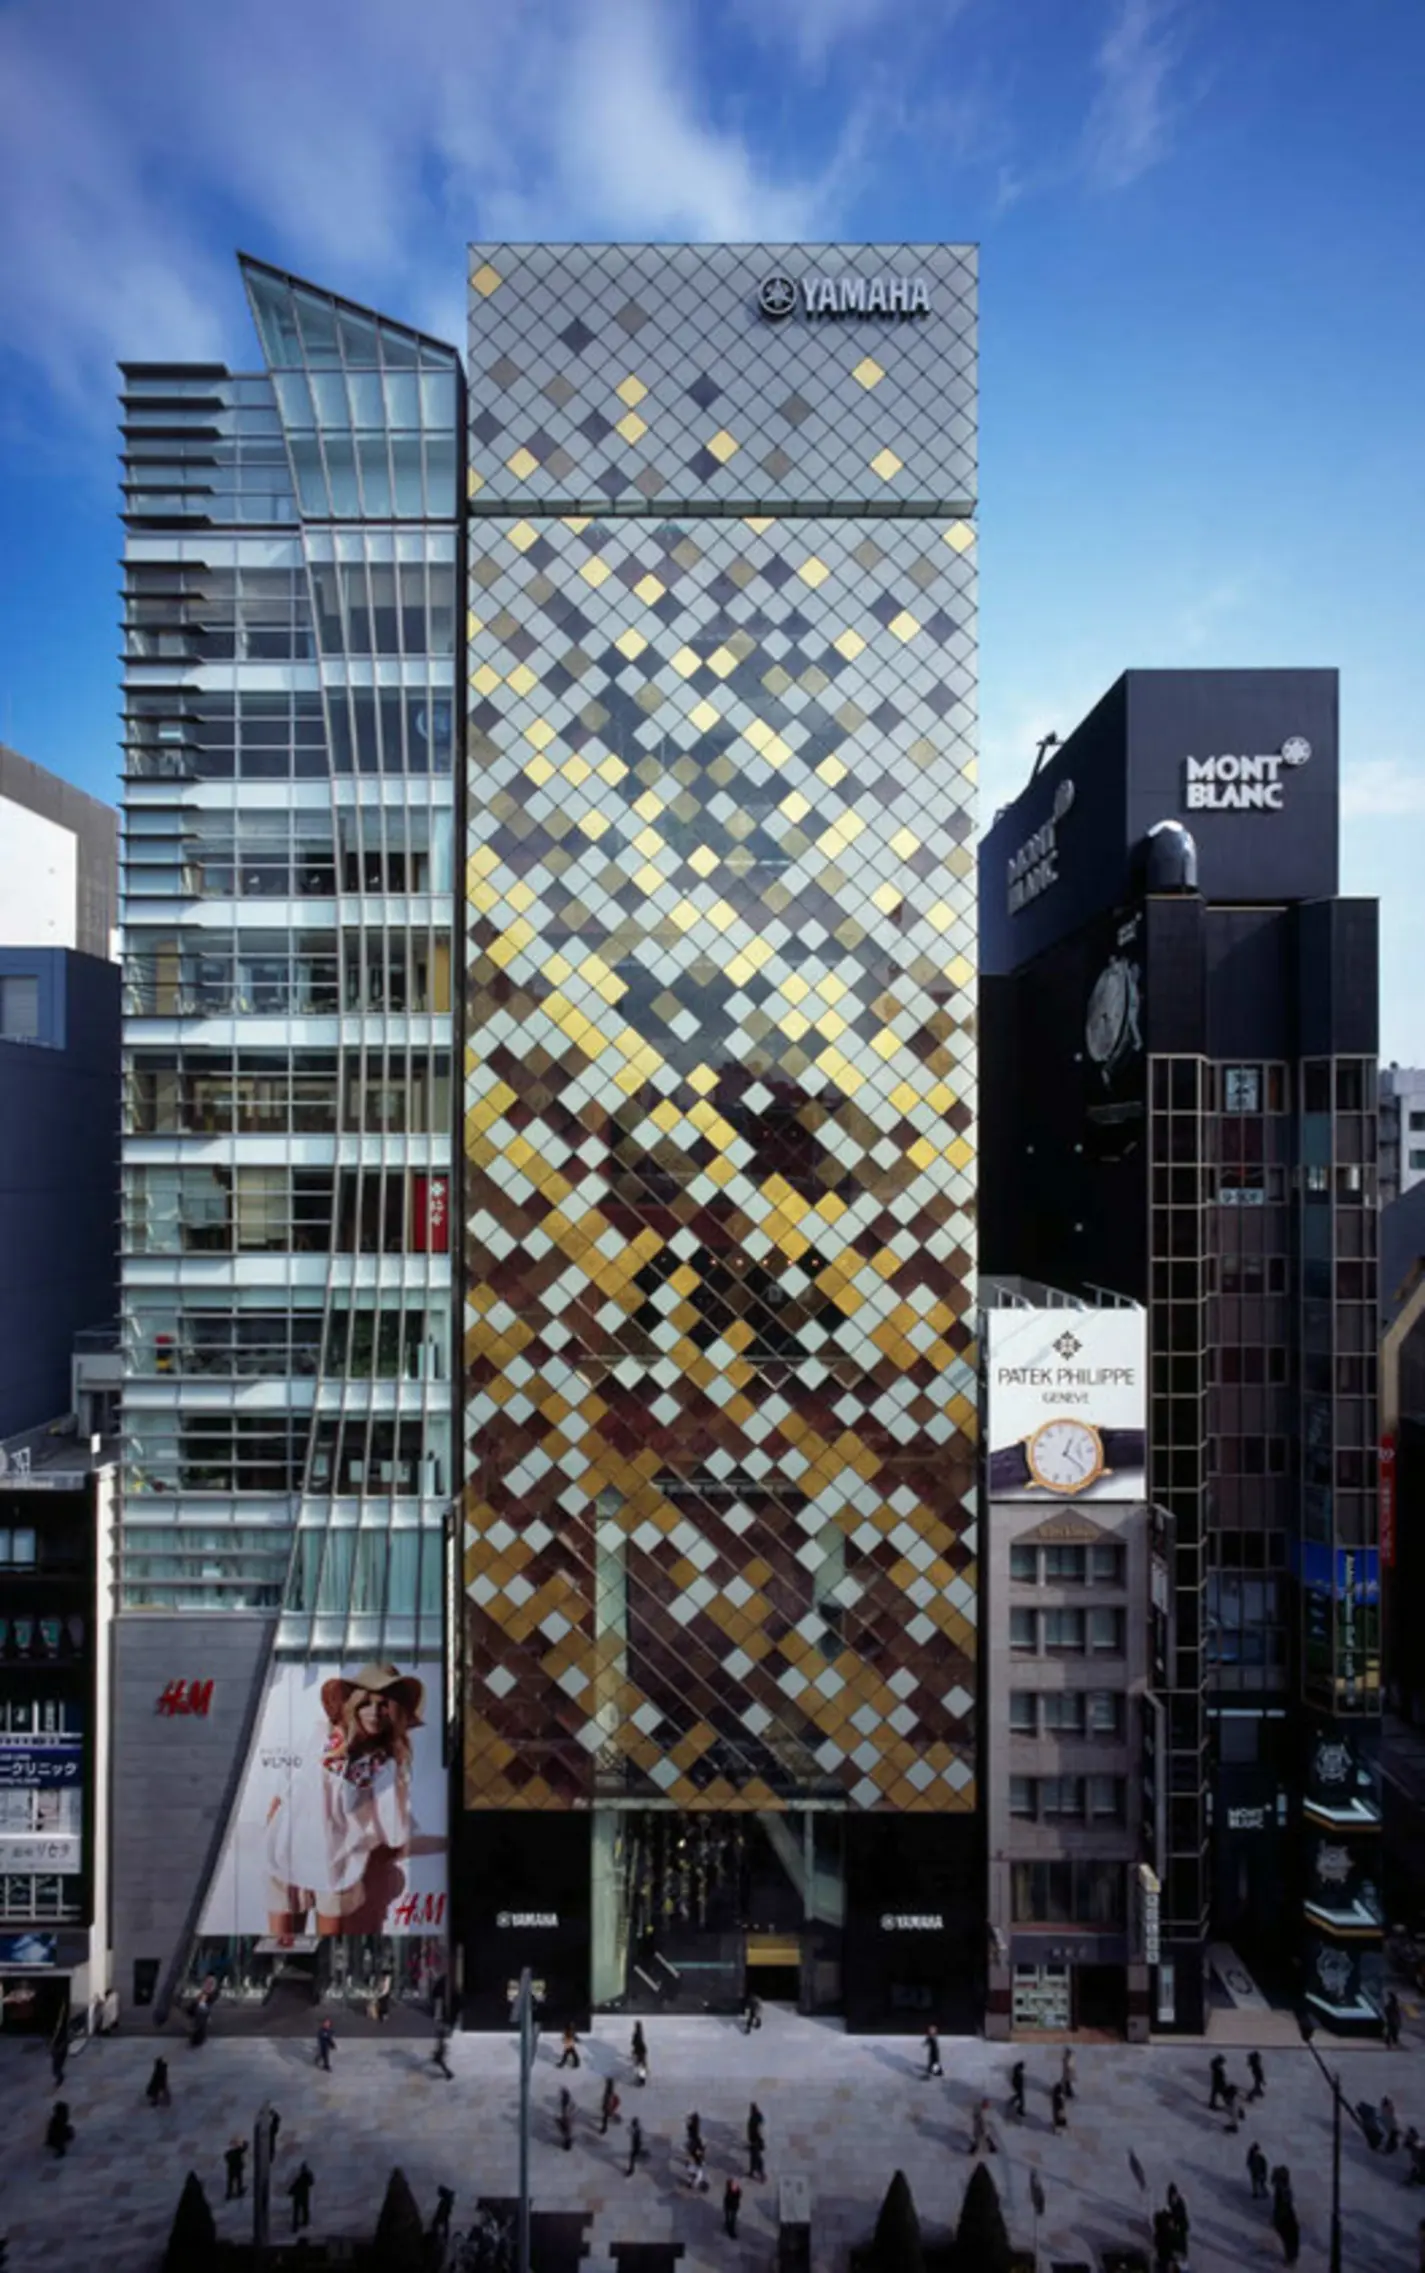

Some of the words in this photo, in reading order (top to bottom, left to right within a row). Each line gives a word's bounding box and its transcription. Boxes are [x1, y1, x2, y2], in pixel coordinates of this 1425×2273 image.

[802, 278, 930, 312] YAMAHA
[1187, 755, 1282, 780] MONT
[1187, 783, 1283, 808] BLANC
[998, 1367, 1053, 1386] PATEK
[1057, 1367, 1135, 1386] PHILIPPE
[512, 1913, 558, 1928] YAMAHA
[897, 1914, 944, 1930] YAMAHA
